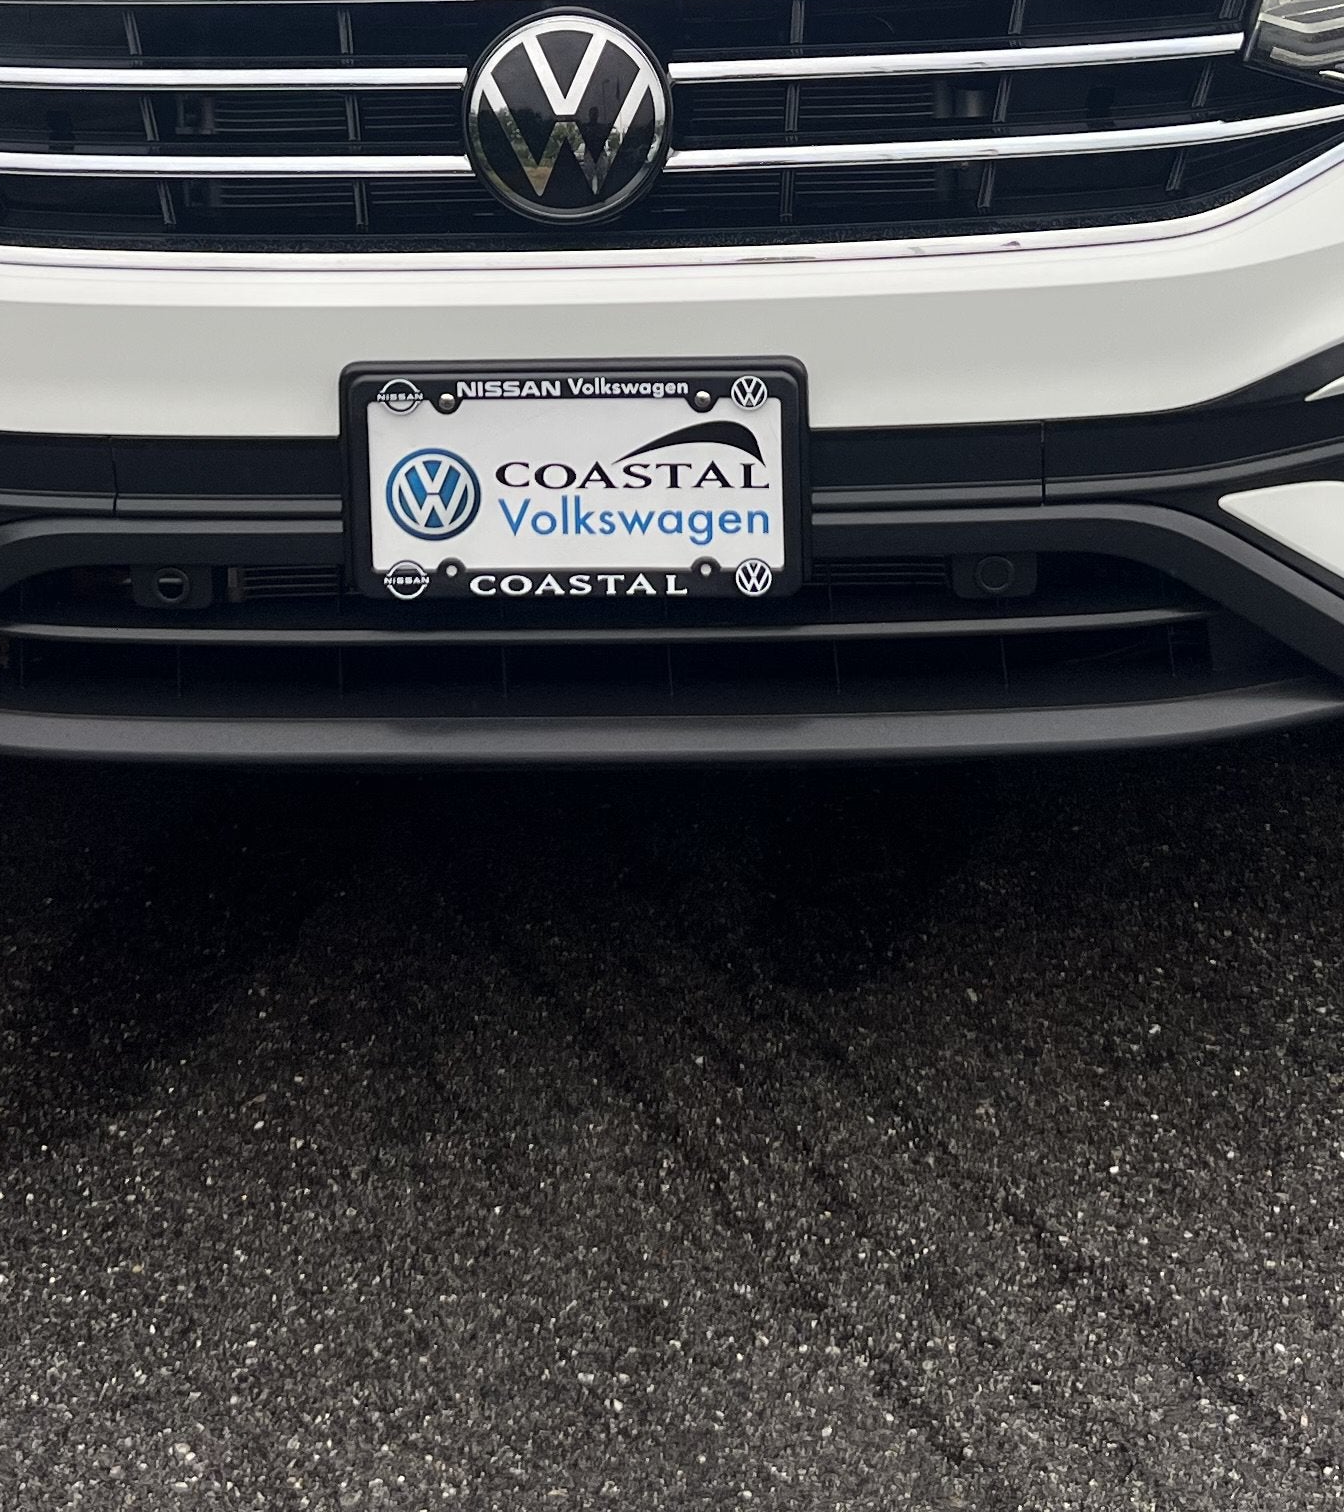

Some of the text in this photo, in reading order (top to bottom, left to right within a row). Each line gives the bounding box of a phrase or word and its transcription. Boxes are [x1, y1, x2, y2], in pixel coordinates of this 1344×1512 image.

[376, 393, 424, 402] NISSAN
[457, 377, 689, 398] NISSAN Volkswagen
[495, 461, 769, 490] COASTAL
[498, 495, 769, 545] Volkswagen
[384, 576, 430, 585] NISSAN
[470, 574, 688, 596] COASTAL
